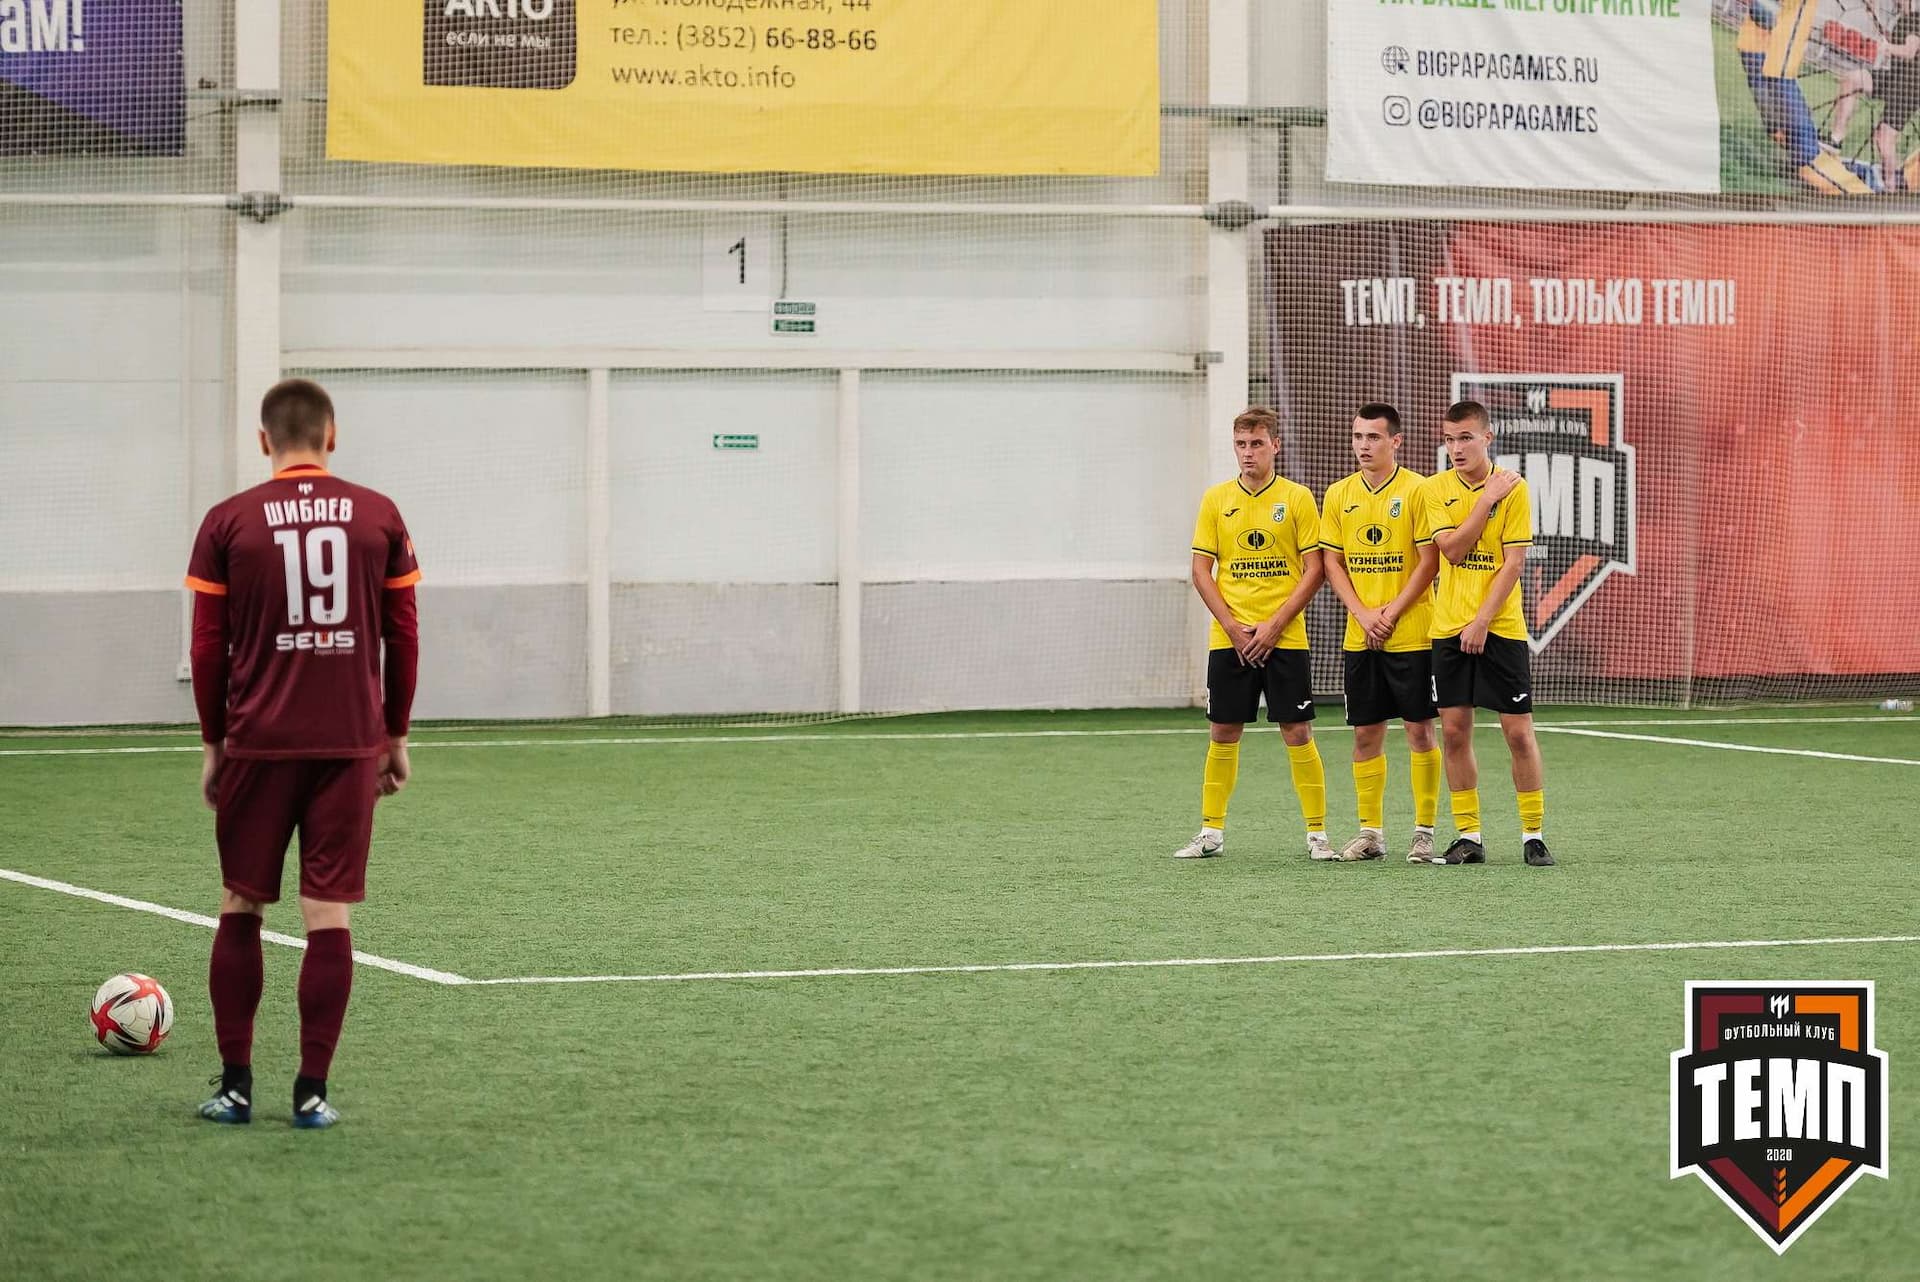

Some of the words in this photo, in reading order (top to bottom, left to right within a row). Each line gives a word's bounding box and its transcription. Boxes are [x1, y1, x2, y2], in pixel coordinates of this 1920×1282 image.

[676, 23, 757, 51] (3852)
[765, 27, 877, 51] 66-88-66
[611, 63, 796, 89] www.akto.info
[1417, 50, 1599, 83] BIGPAPAGAMES.RU
[1418, 99, 1599, 133] @BIGPAPAGAMES
[728, 237, 745, 284] 1
[1341, 278, 1426, 328] ТЕМП,
[1434, 278, 1521, 328] ТЕМП,
[1530, 279, 1642, 325] ТОЛЬКО
[1652, 280, 1736, 326] ТЕМП!
[1491, 417, 1555, 434] УТБОЛЬНЫЙ
[263, 498, 353, 527] ШИБАЕВ
[1495, 452, 1615, 546] МП
[273, 526, 349, 626] 19
[276, 630, 355, 651] SEUS
